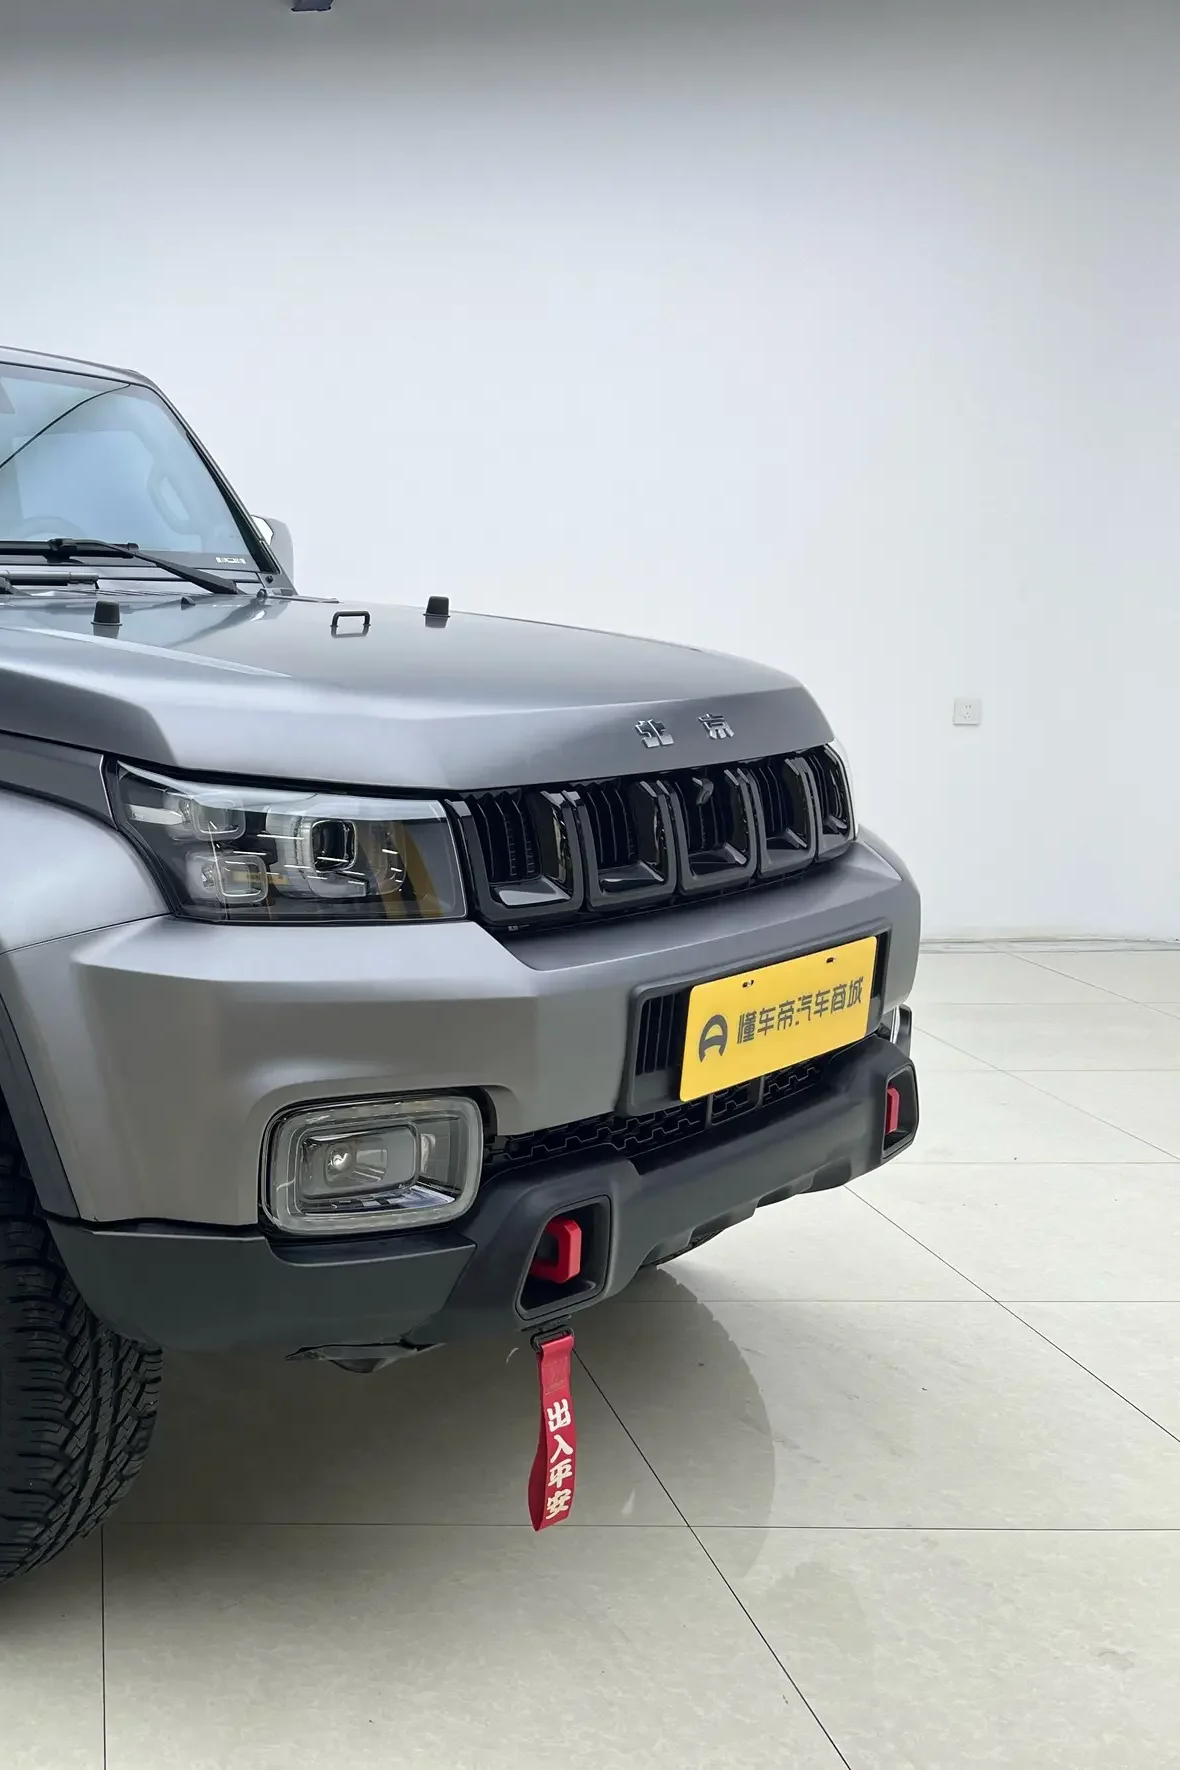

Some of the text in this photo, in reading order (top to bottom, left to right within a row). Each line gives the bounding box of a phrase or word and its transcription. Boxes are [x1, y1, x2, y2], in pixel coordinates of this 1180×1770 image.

[635, 713, 734, 748] 北京
[546, 1398, 574, 1520] 出入平安
